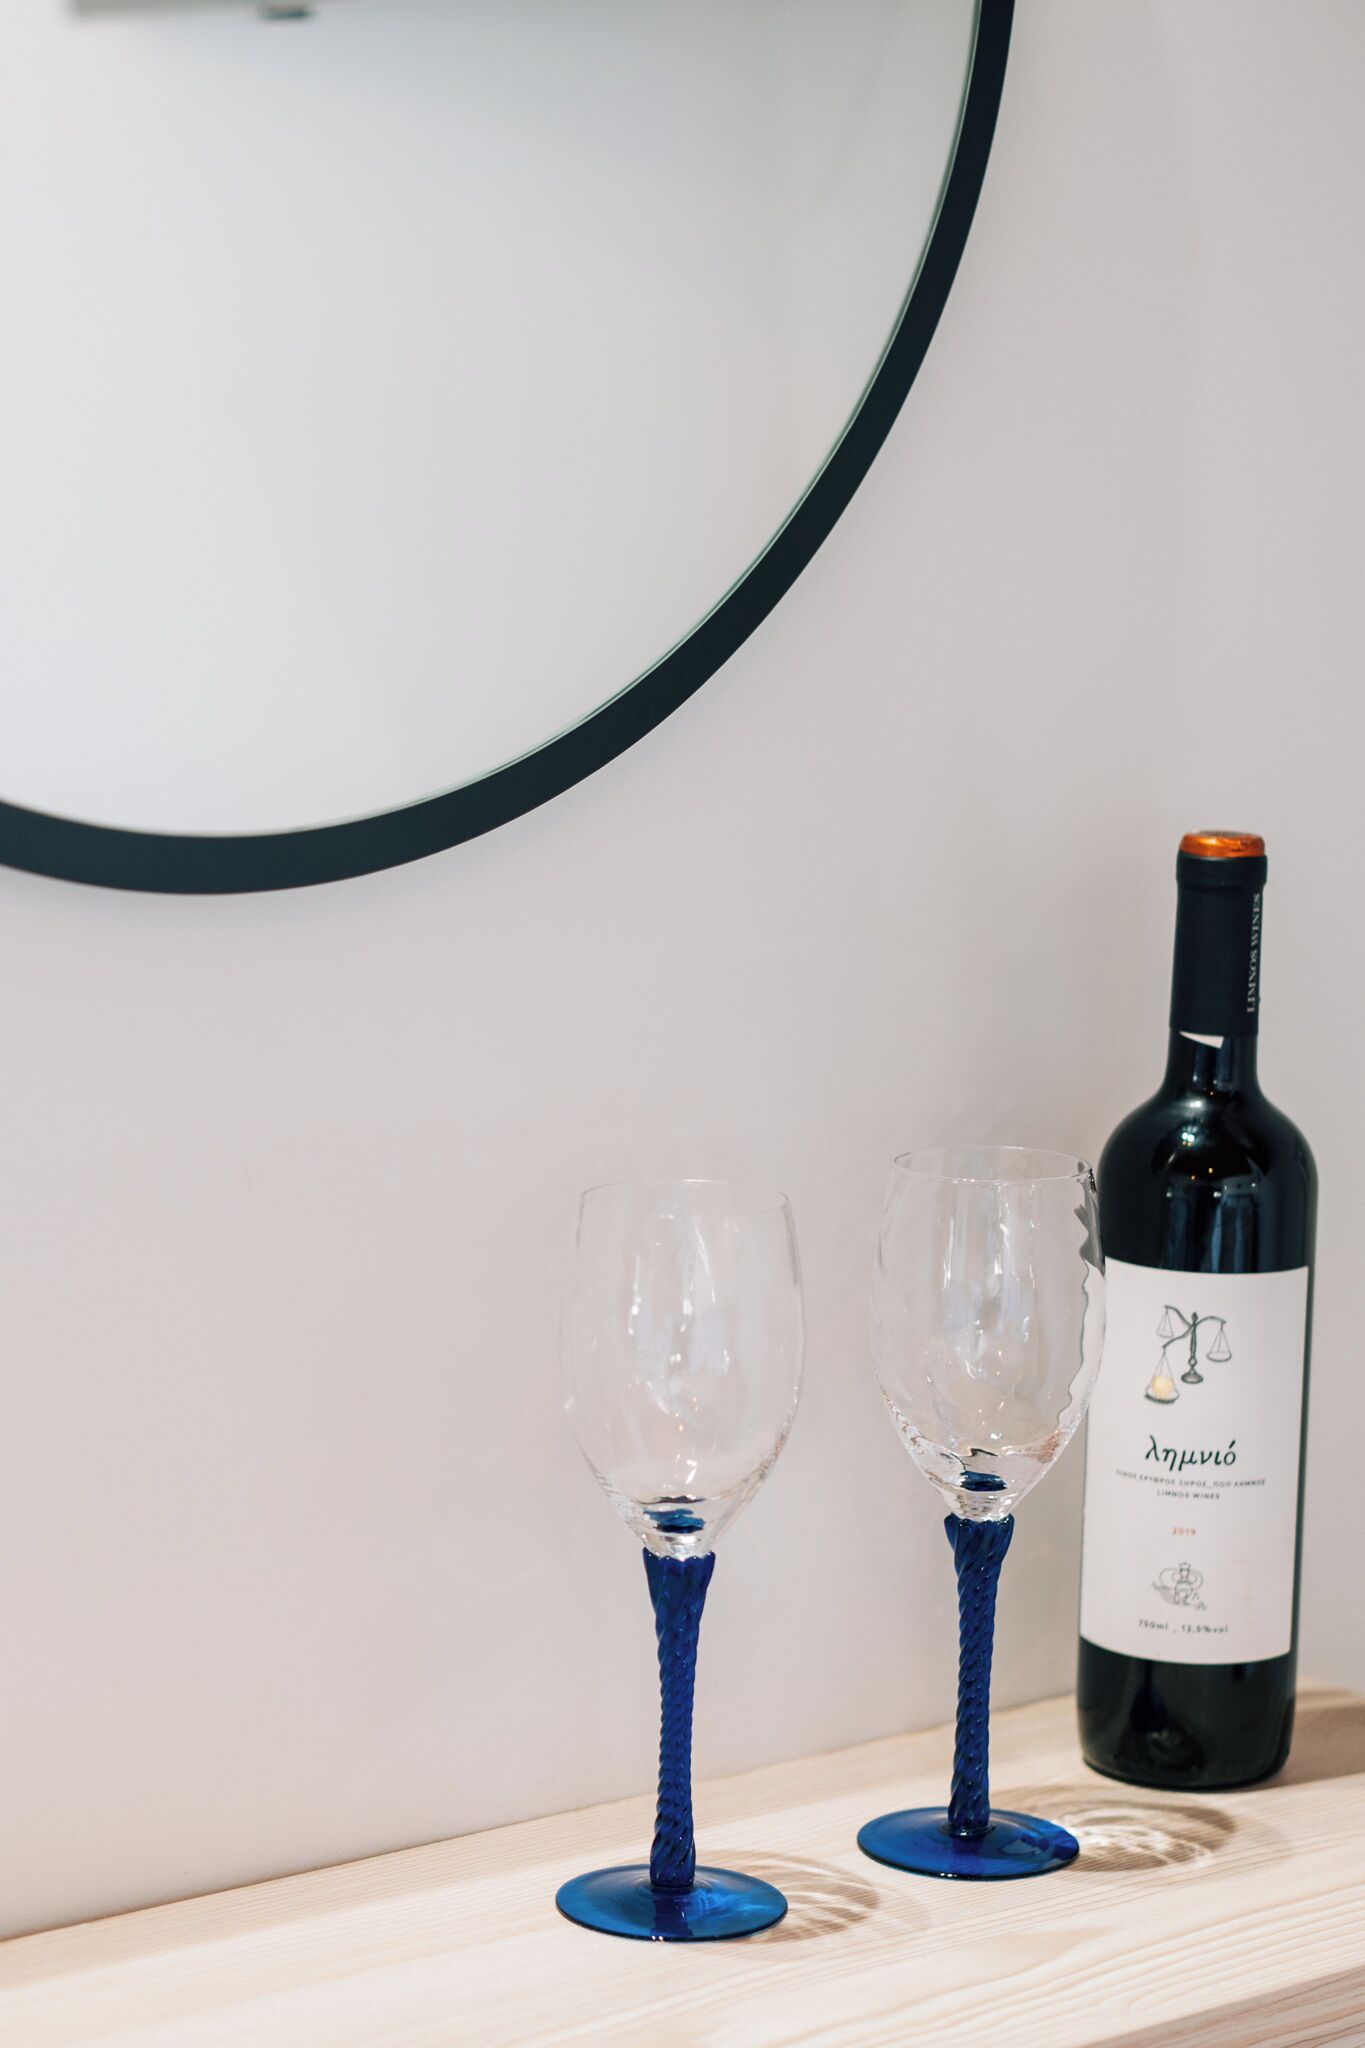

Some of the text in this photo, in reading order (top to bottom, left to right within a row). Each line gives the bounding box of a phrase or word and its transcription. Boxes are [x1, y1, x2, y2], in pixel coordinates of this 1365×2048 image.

[1246, 892, 1261, 1012] LIMNOS WINES
[1145, 1434, 1236, 1472] λημνιό
[1157, 1489, 1190, 1498] LIMNOS
[1172, 1527, 1197, 1536] 2019
[1138, 1619, 1169, 1631] 750ml
